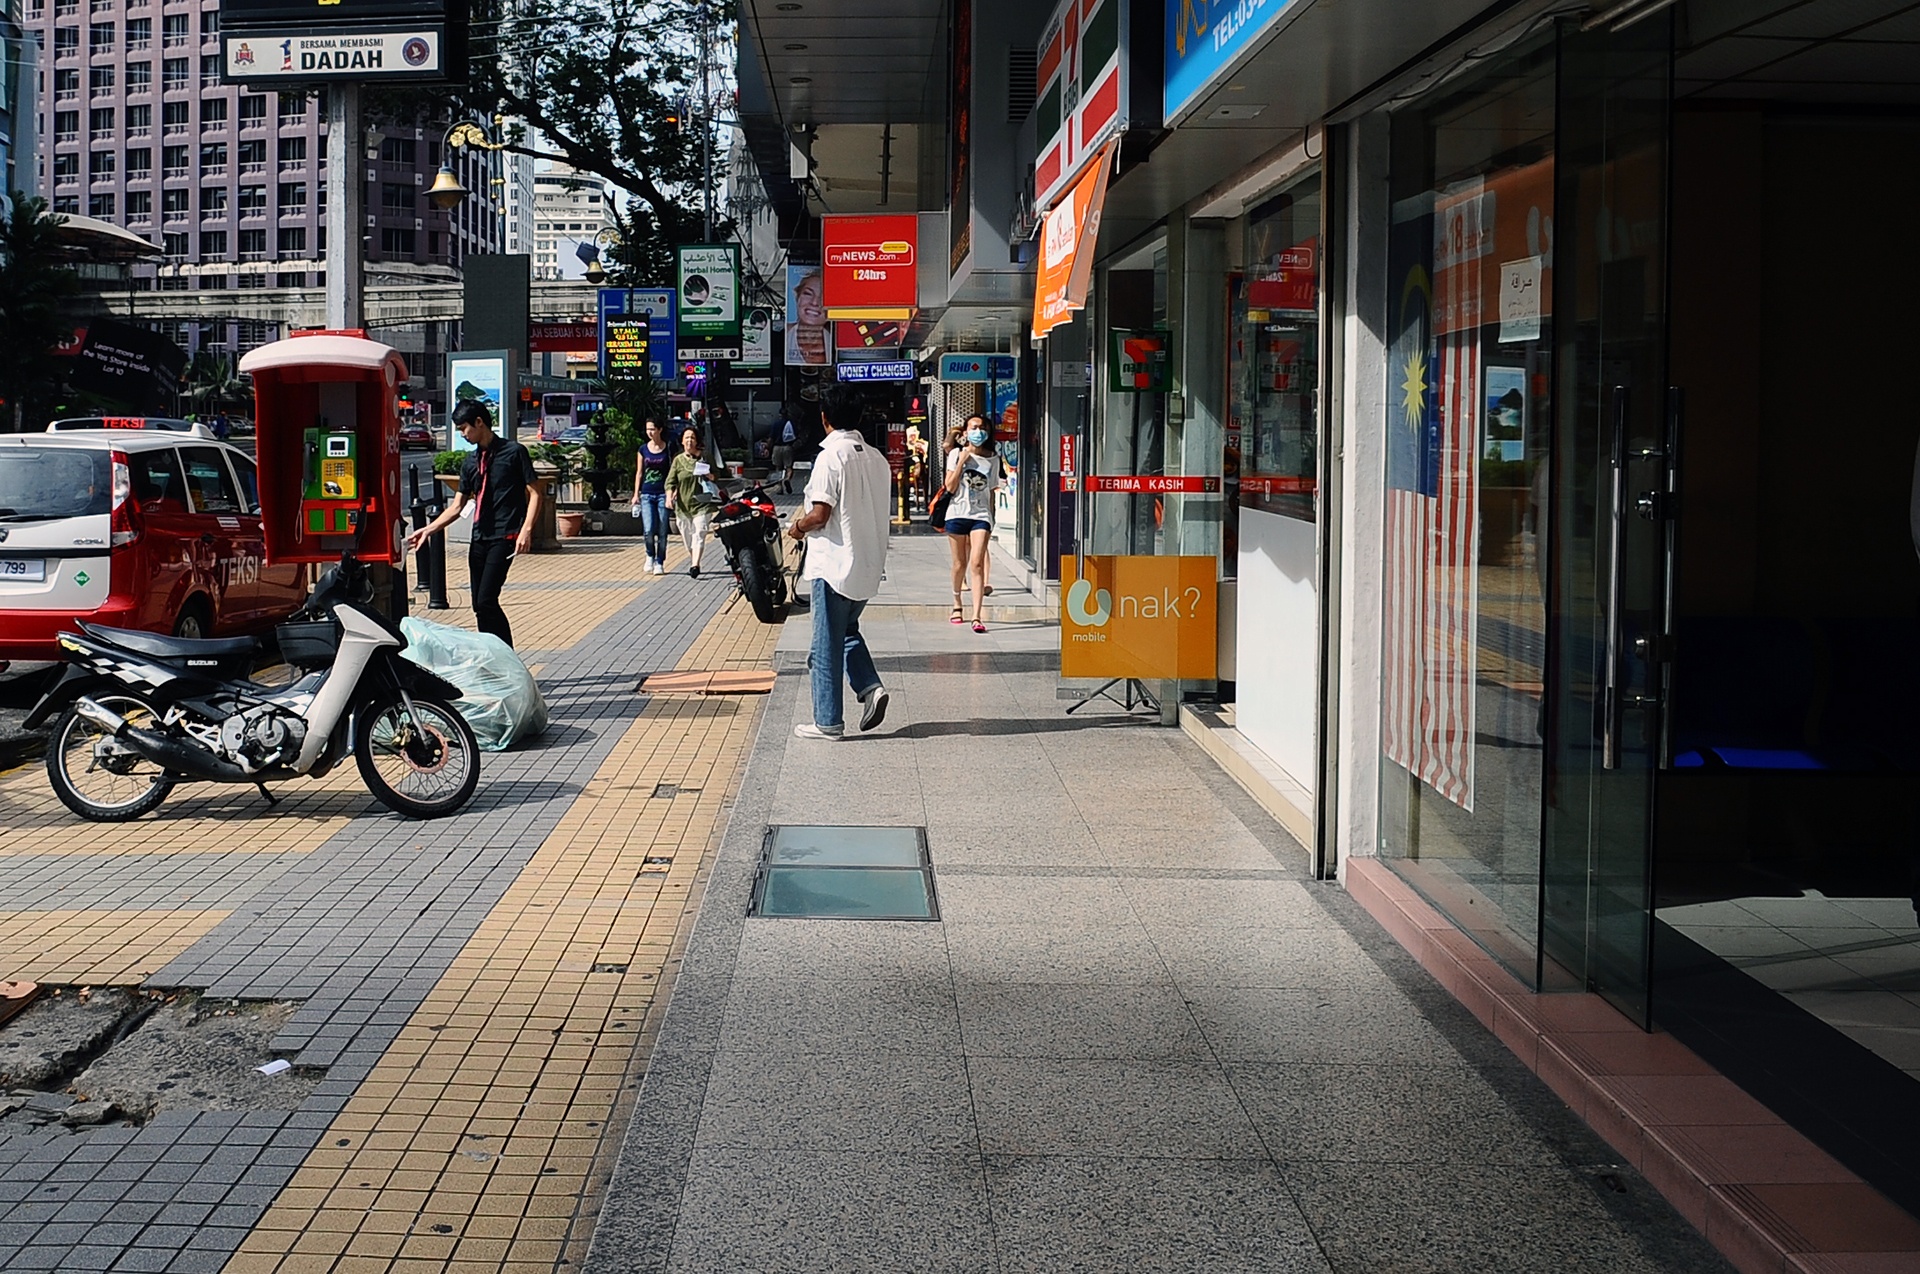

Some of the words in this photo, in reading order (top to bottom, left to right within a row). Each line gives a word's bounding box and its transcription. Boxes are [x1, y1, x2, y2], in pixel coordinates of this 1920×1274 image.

[300, 39, 337, 49] BERSAMA
[339, 38, 384, 48] MEMBASMI
[301, 50, 383, 70] DADAH
[684, 266, 709, 274] Herbal
[710, 266, 732, 274] Home
[544, 328, 574, 338] SEBUAH
[94, 342, 115, 353] Learn
[116, 348, 135, 359] more
[83, 349, 96, 358] the
[109, 355, 128, 367] Store
[129, 361, 151, 373] inside
[949, 361, 972, 373] RHB
[102, 365, 114, 373] Lot
[839, 365, 869, 378] MONEY
[871, 364, 911, 377] CHANGER
[102, 417, 146, 429] TEKSI
[1099, 479, 1141, 490] TERIMA
[1149, 479, 1184, 490] KASIH
[220, 556, 259, 587] TEKSI
[1120, 586, 1202, 619] nak?
[1072, 632, 1107, 643] mobile
